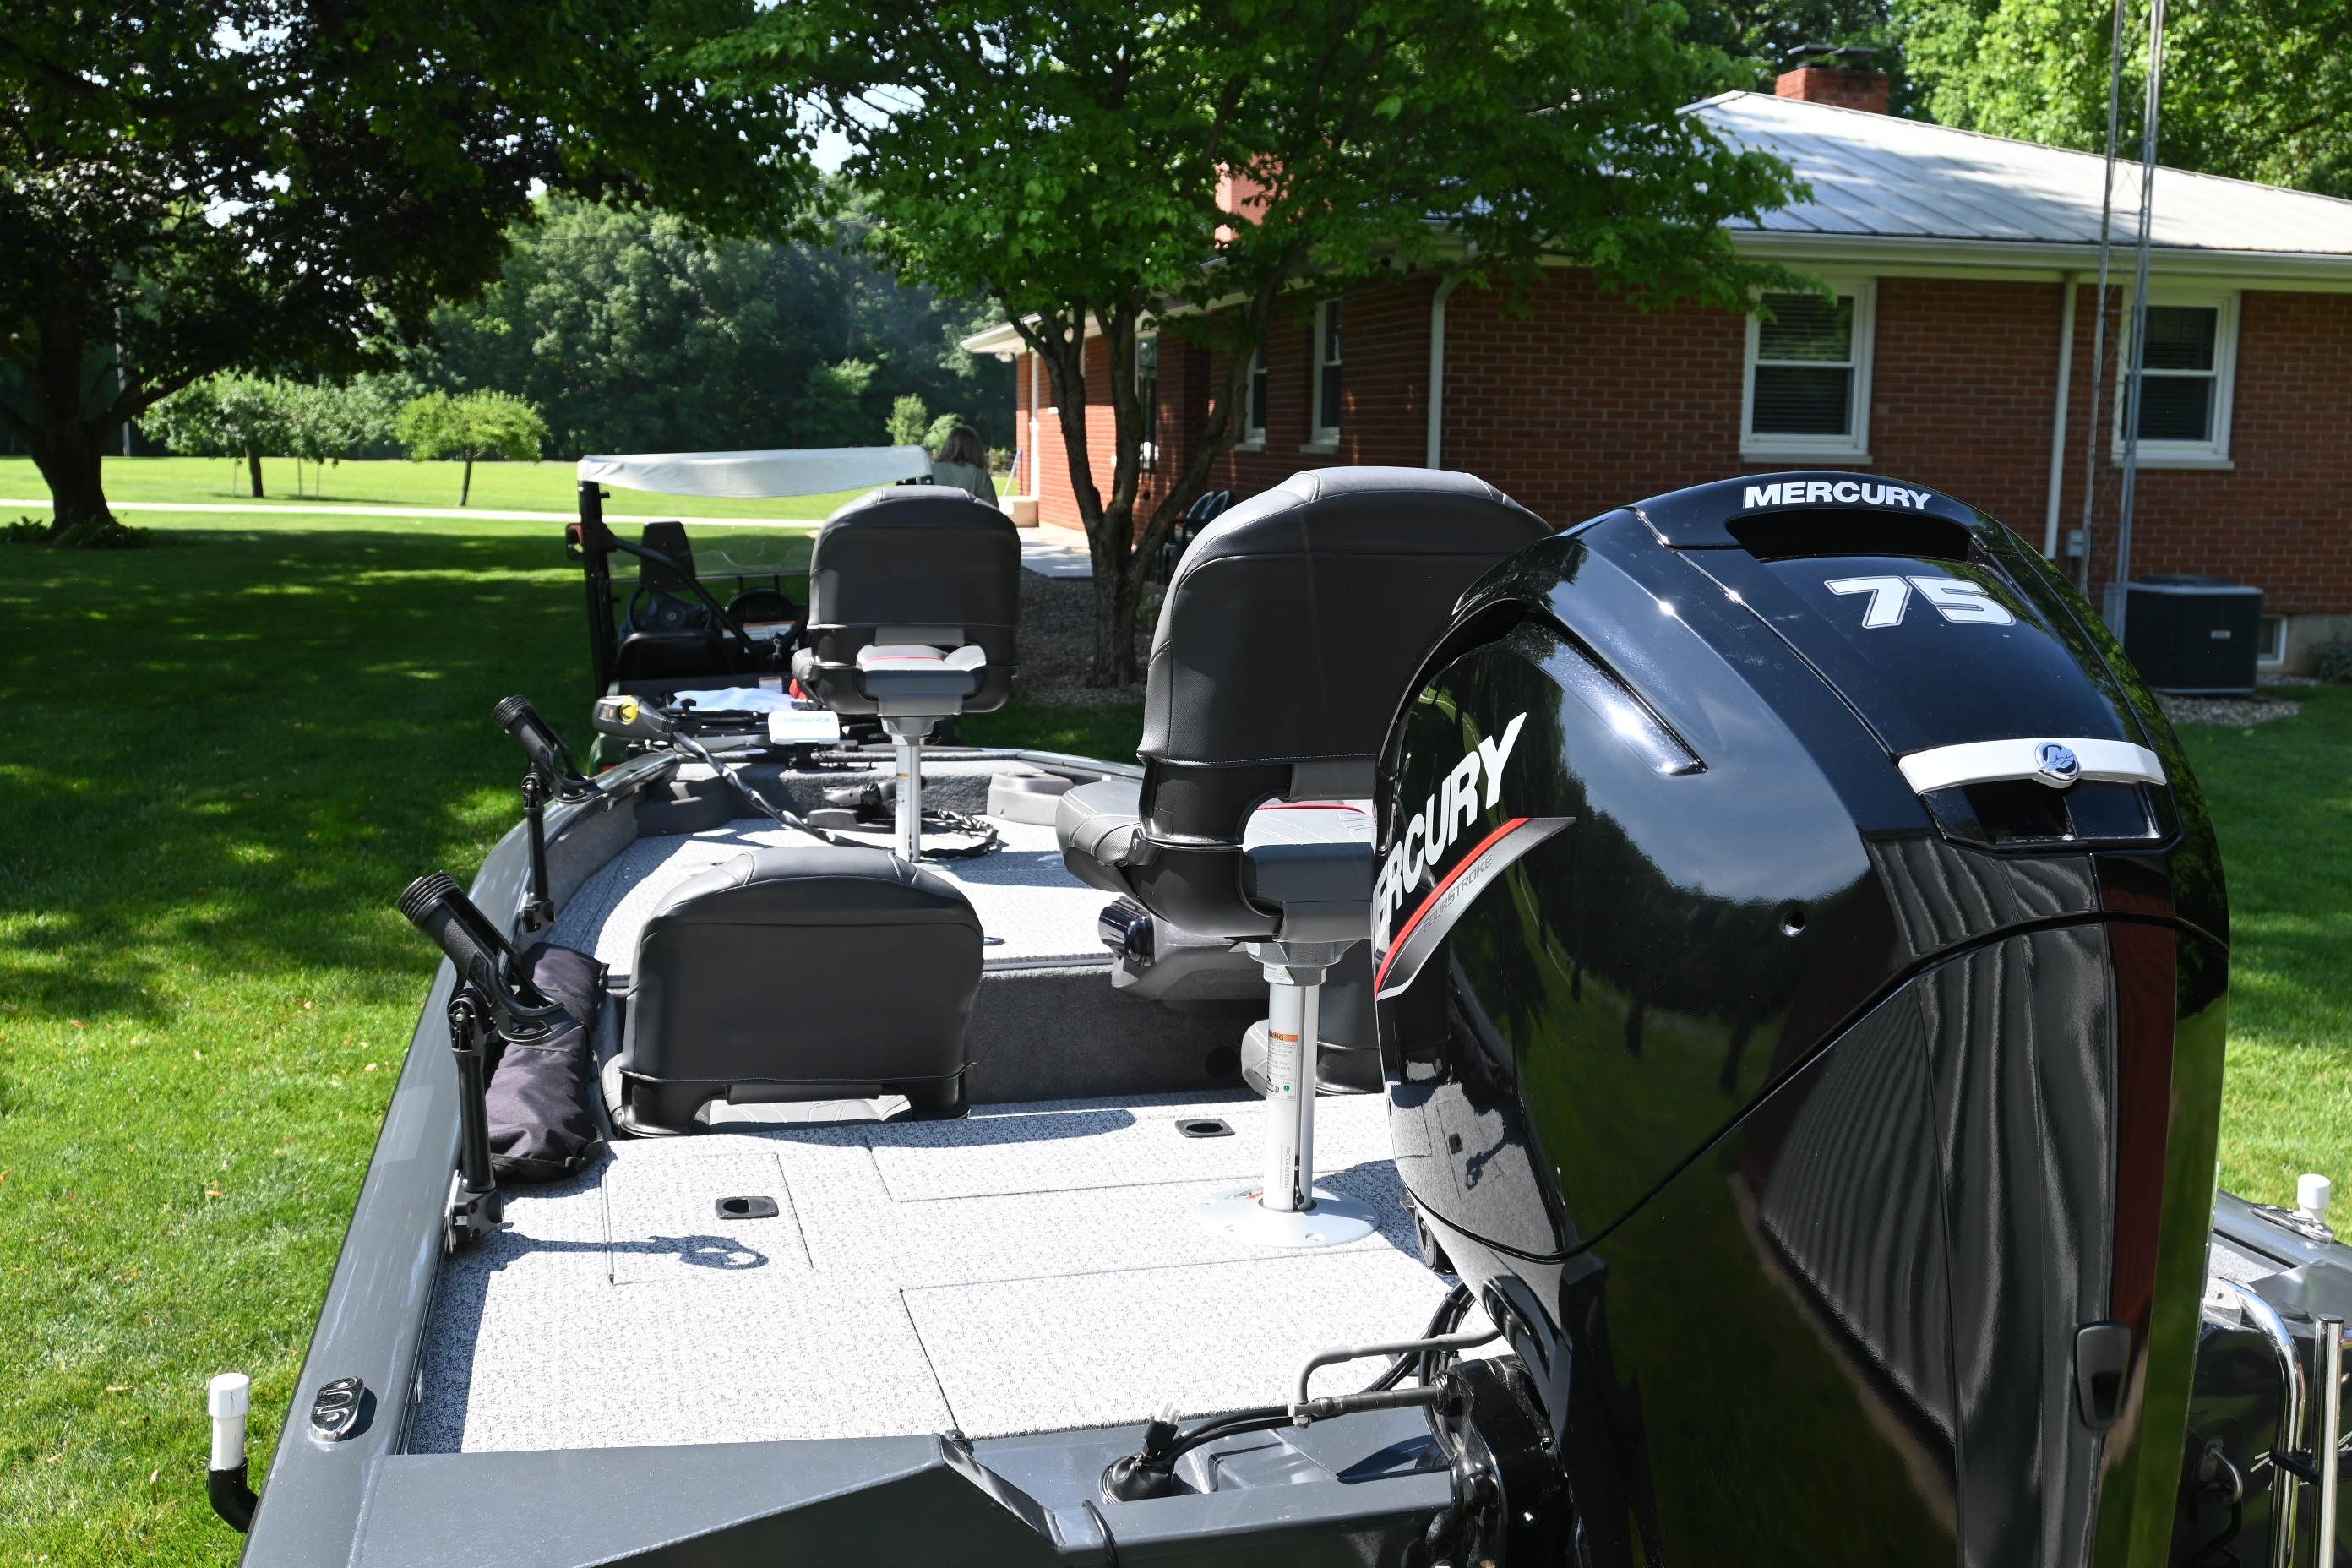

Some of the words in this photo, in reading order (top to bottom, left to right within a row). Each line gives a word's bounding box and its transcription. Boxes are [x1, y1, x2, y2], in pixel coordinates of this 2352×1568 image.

[1743, 481, 1932, 511] MERCURY
[1824, 575, 2017, 629] 75
[1373, 711, 1527, 939] ERCURY
[1422, 853, 1494, 933] FOURSTROKE
